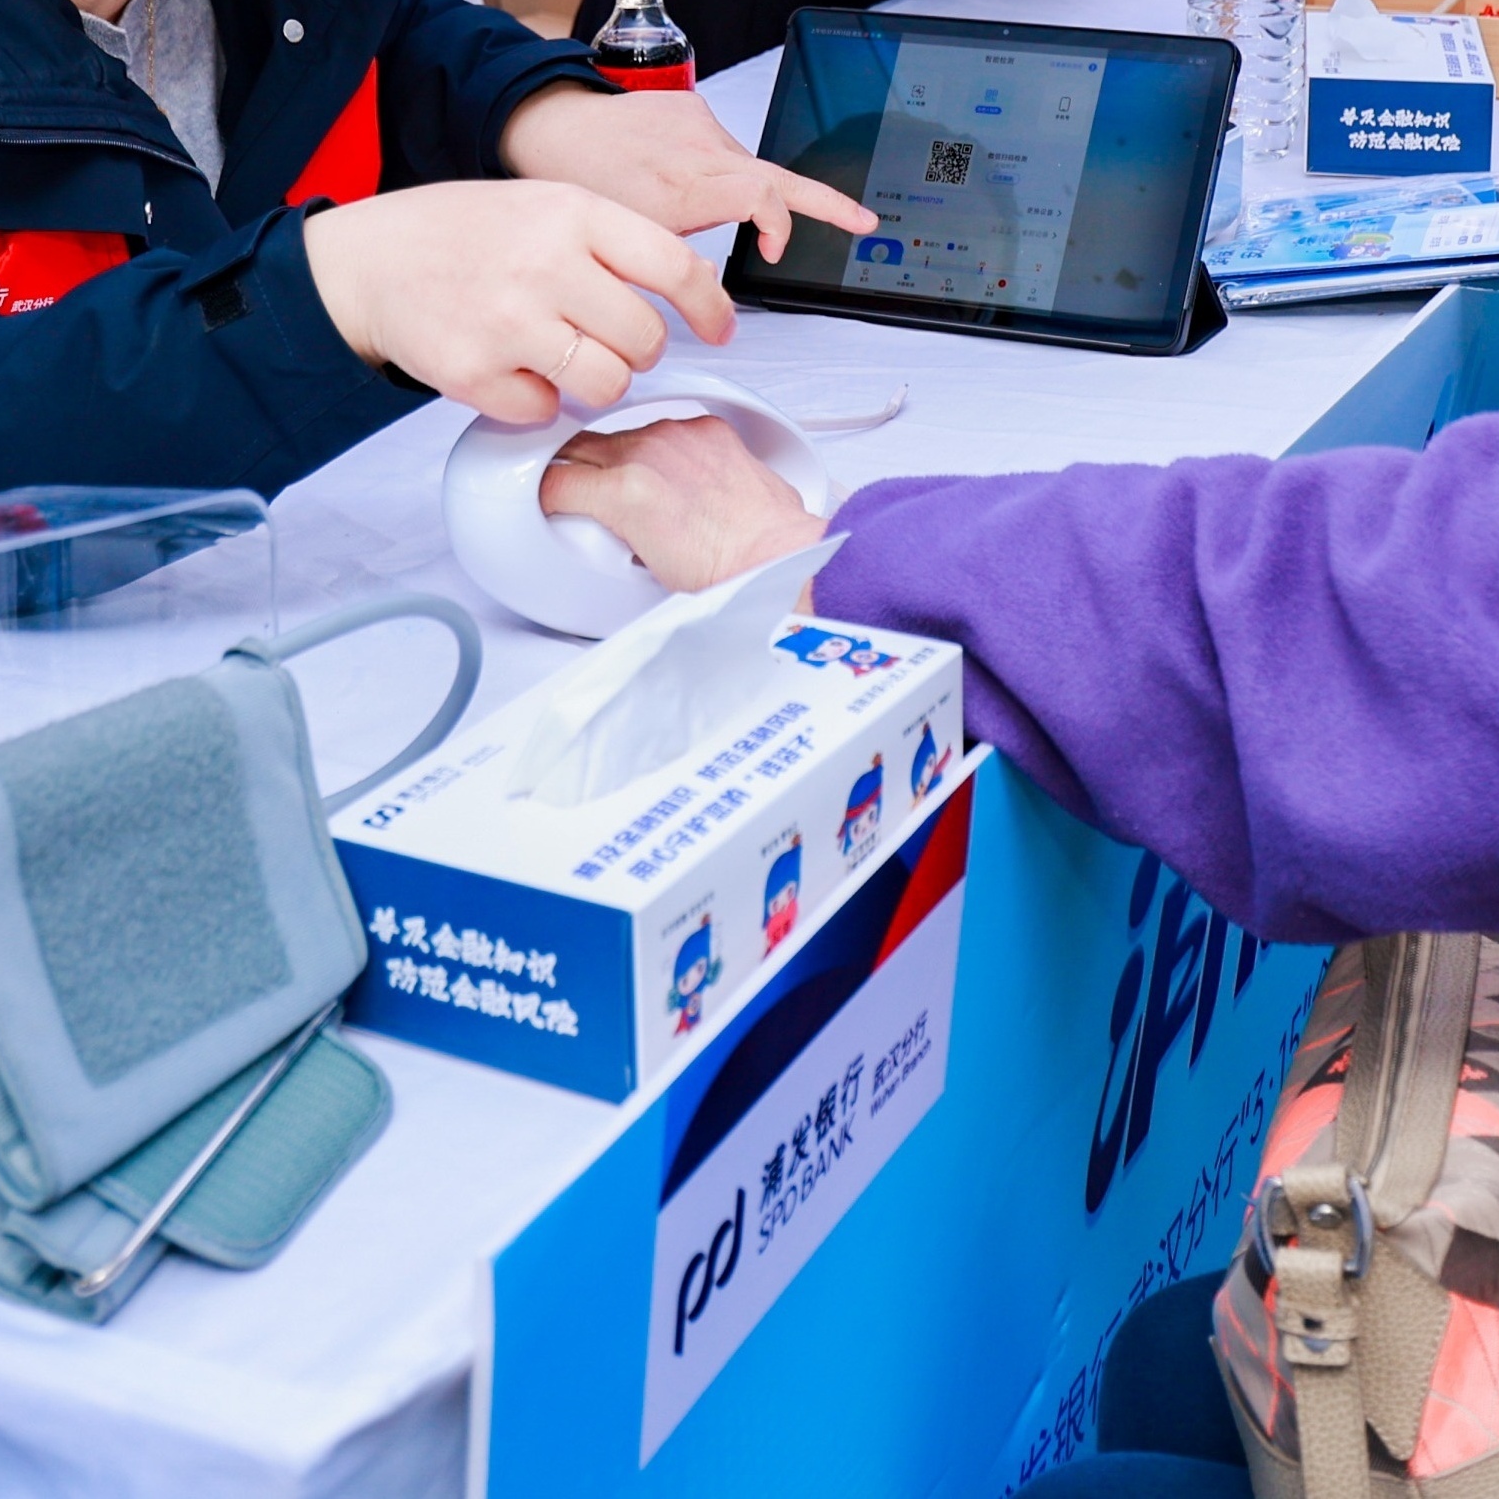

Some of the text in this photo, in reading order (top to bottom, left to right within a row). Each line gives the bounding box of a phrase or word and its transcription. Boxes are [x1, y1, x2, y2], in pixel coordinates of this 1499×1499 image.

[1339, 106, 1451, 129] 普及金融知识
[1348, 130, 1462, 151] 防范金融风险
[10, 296, 55, 313] 武汉分行
[369, 905, 558, 989] 普及金融知识
[386, 956, 579, 1037] 防范金融风险
[901, 1038, 932, 1083] Branch
[759, 1008, 929, 1214] 浦发银行 武汉分行
[758, 1111, 856, 1256] SPD BANK
